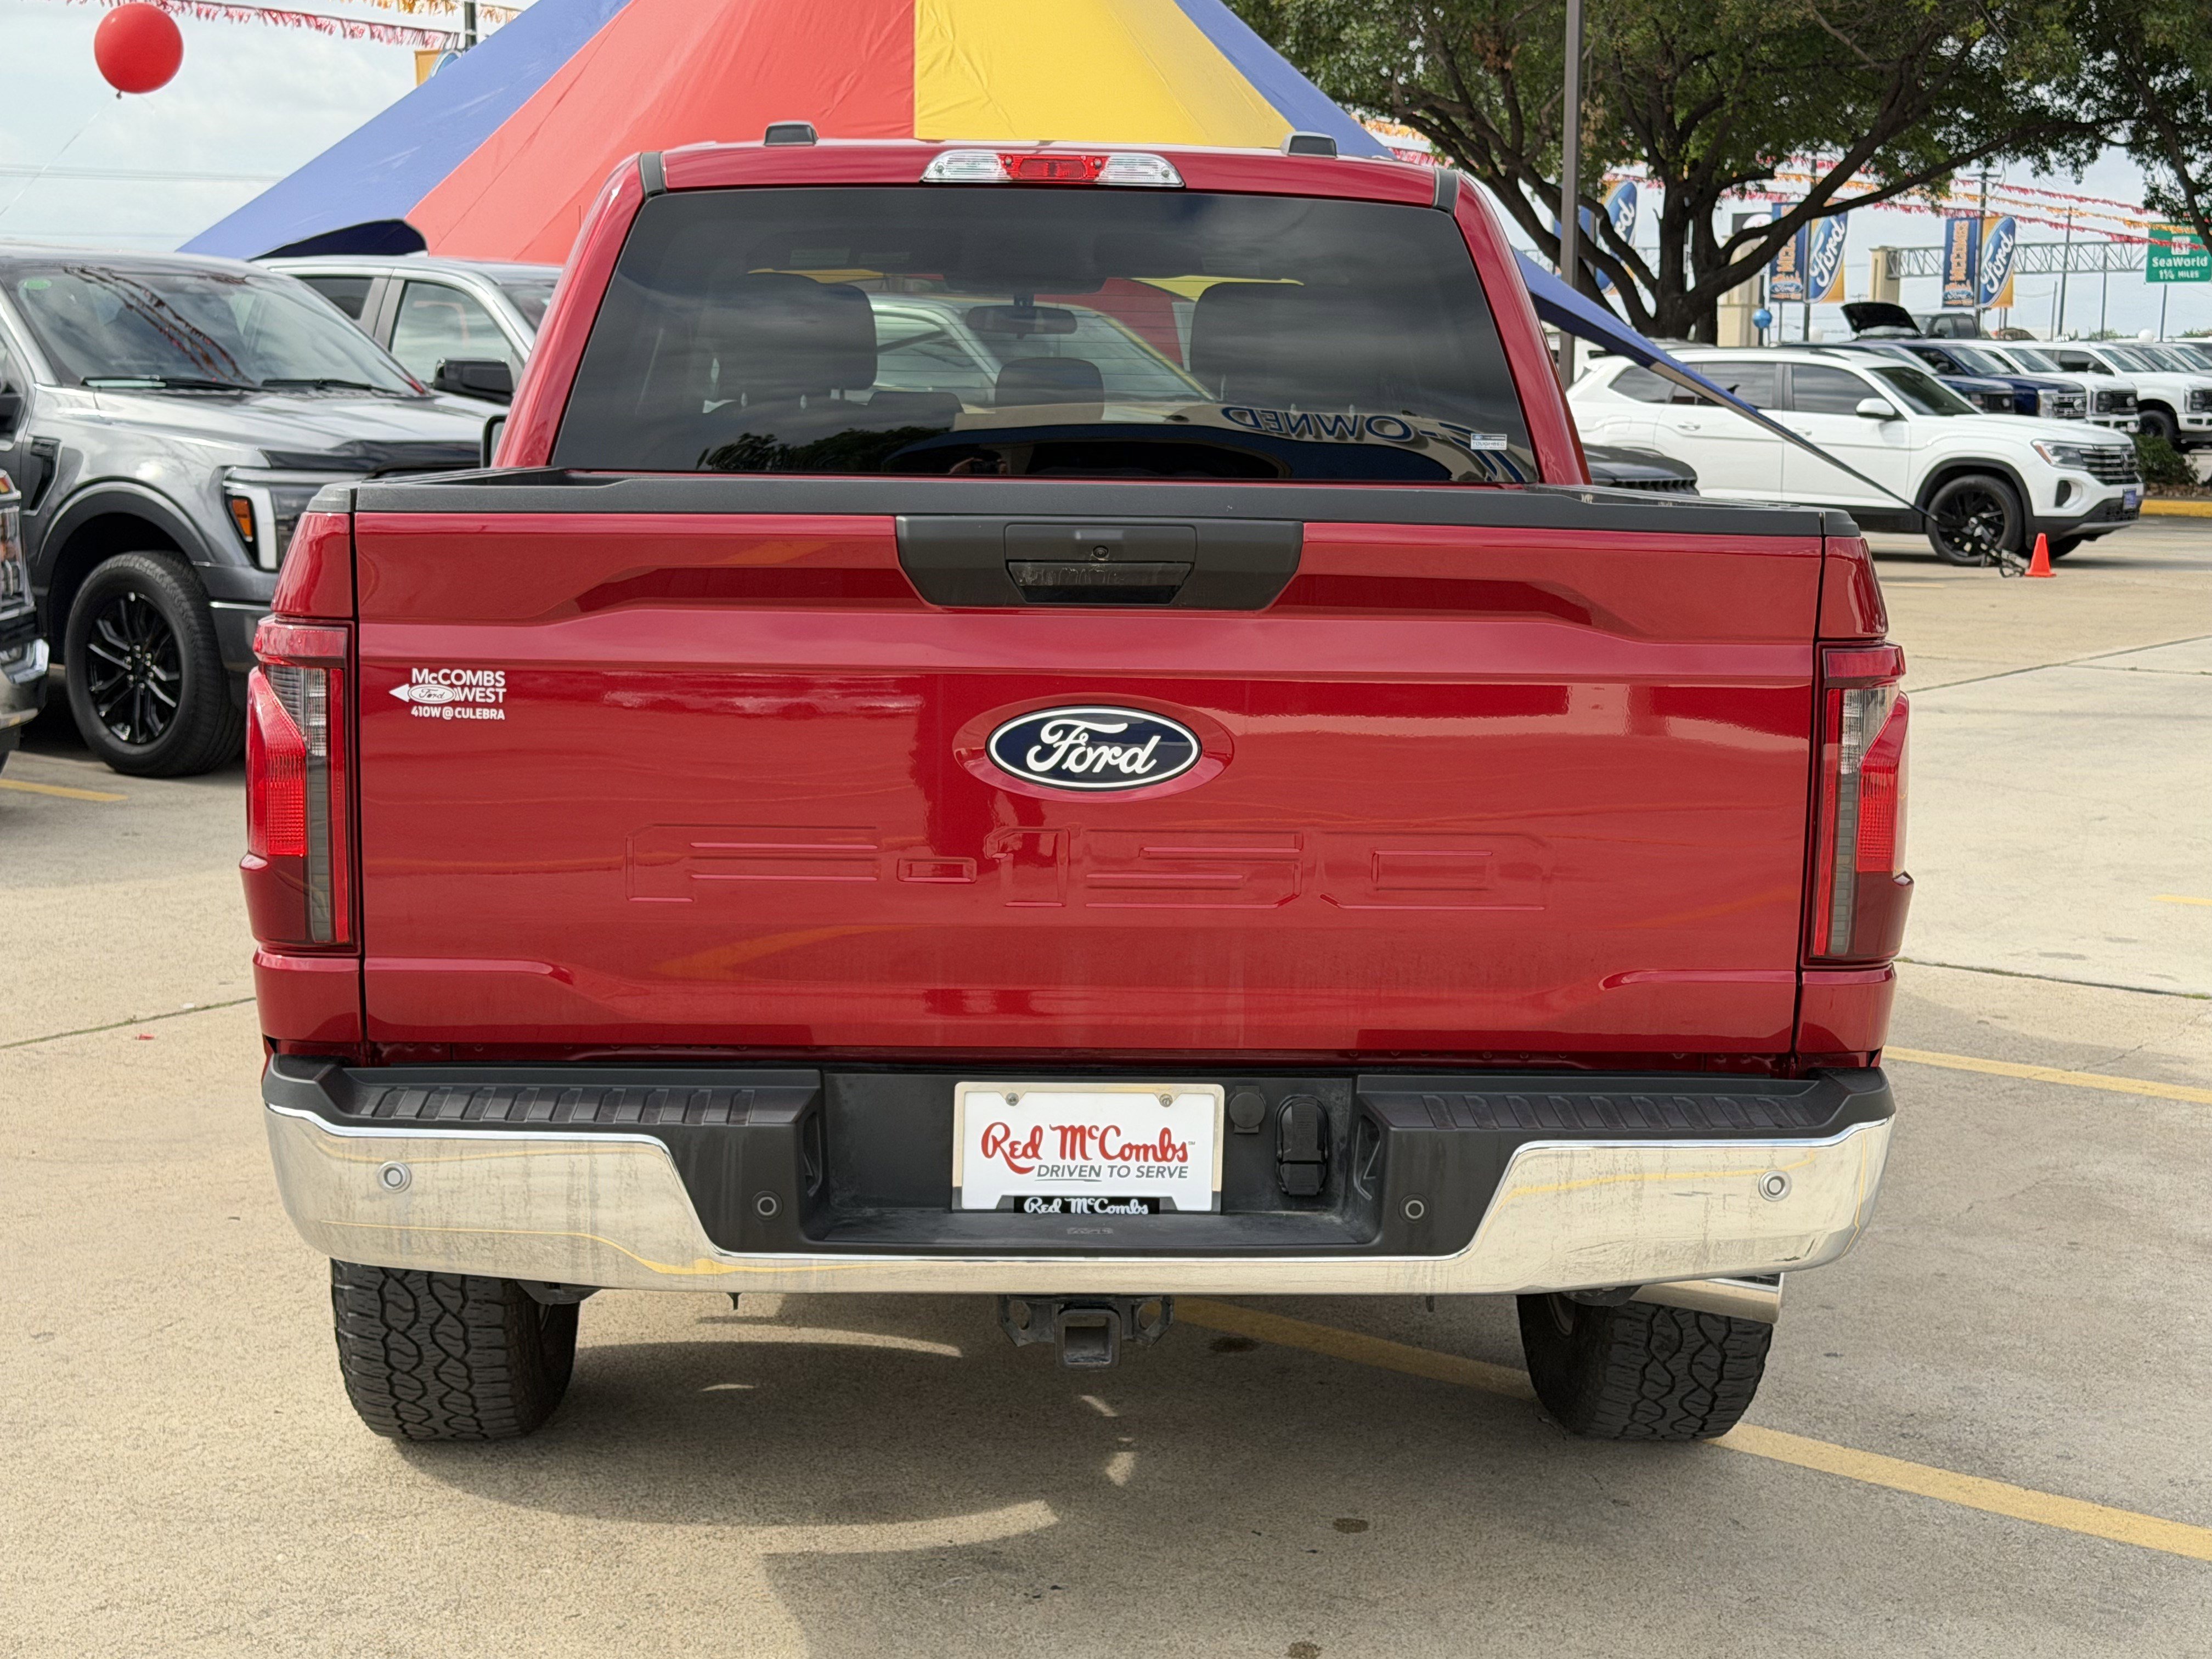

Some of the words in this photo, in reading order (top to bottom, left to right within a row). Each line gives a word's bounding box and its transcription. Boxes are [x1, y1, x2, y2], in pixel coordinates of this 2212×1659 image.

[1613, 198, 1635, 242] rd
[1809, 215, 1845, 287] Ford
[1980, 230, 2013, 294] Ford
[2152, 256, 2208, 267] SeaWorld
[412, 668, 506, 687] McCOMBS
[419, 689, 446, 699] Ford
[458, 687, 507, 703] WEST
[1026, 719, 1161, 774] Ford
[981, 1121, 1043, 1175] Red
[1049, 1124, 1189, 1163] McCombs
[1037, 1164, 1103, 1178] DRIVEN
[1107, 1165, 1131, 1178] TO
[1135, 1165, 1189, 1179] SERVE
[1024, 1197, 1062, 1215] Red
[1064, 1197, 1149, 1215] McCombs
